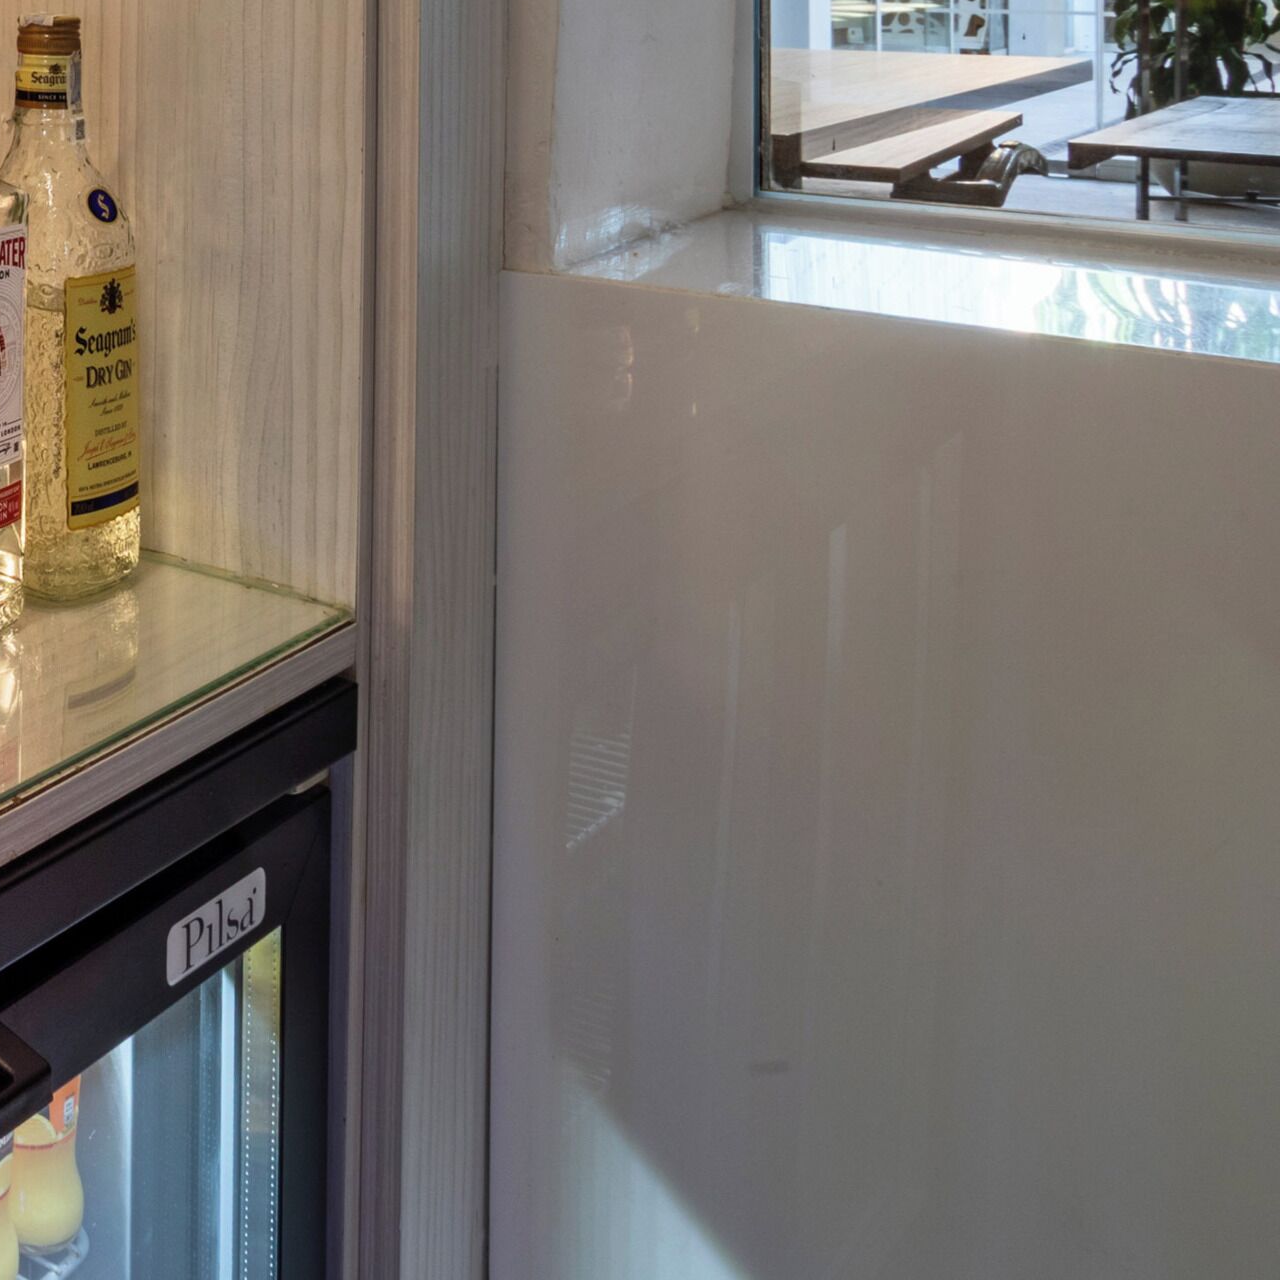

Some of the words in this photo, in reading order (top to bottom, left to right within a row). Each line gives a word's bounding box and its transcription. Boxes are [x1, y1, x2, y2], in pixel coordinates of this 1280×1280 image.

[74, 318, 136, 358] Seagram's
[86, 364, 114, 389] DRY
[115, 358, 132, 382] GIN
[1, 425, 21, 438] LONDON
[181, 887, 257, 975] Pilsa
